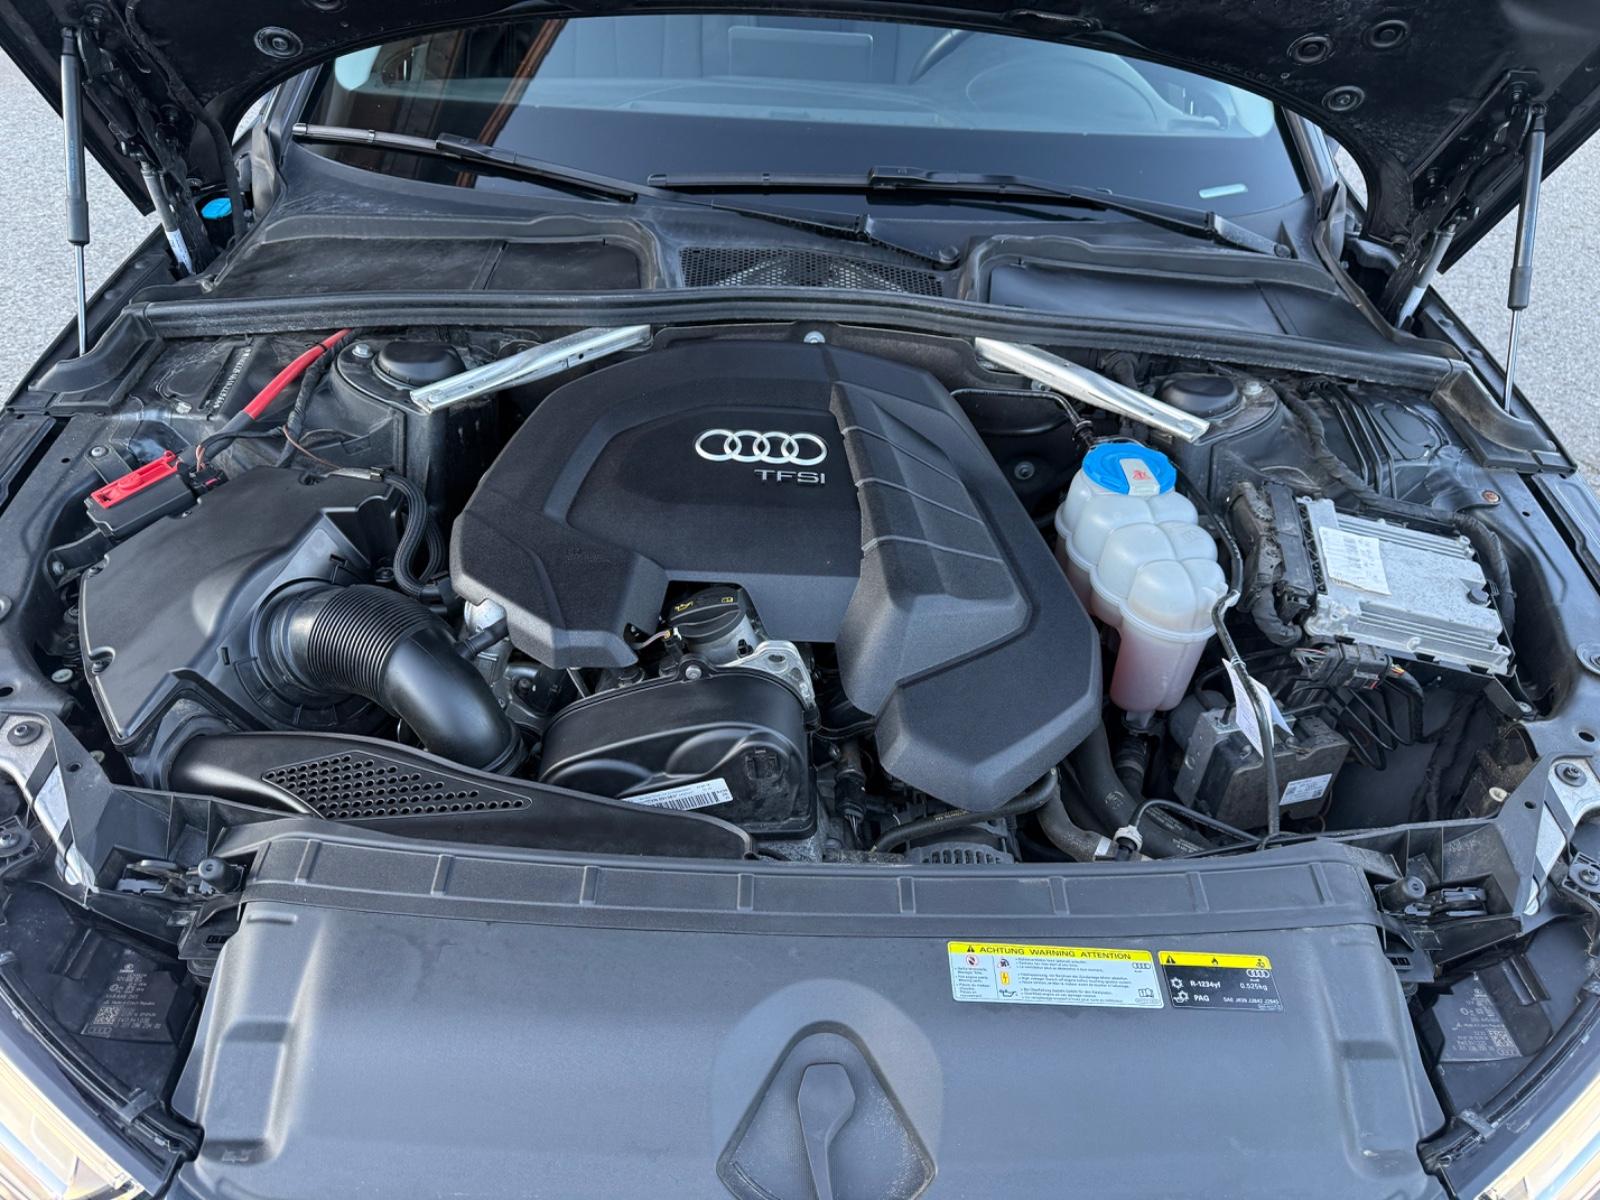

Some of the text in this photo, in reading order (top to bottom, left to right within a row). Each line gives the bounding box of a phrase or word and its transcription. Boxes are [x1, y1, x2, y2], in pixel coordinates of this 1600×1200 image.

[754, 469, 826, 484] TFSI
[980, 947, 1131, 960] ACHTUNG WARNING ATTENTION
[1189, 980, 1221, 989] R-1234yf
[1239, 982, 1268, 991] 0.525kg
[1193, 994, 1210, 1002] PAG
